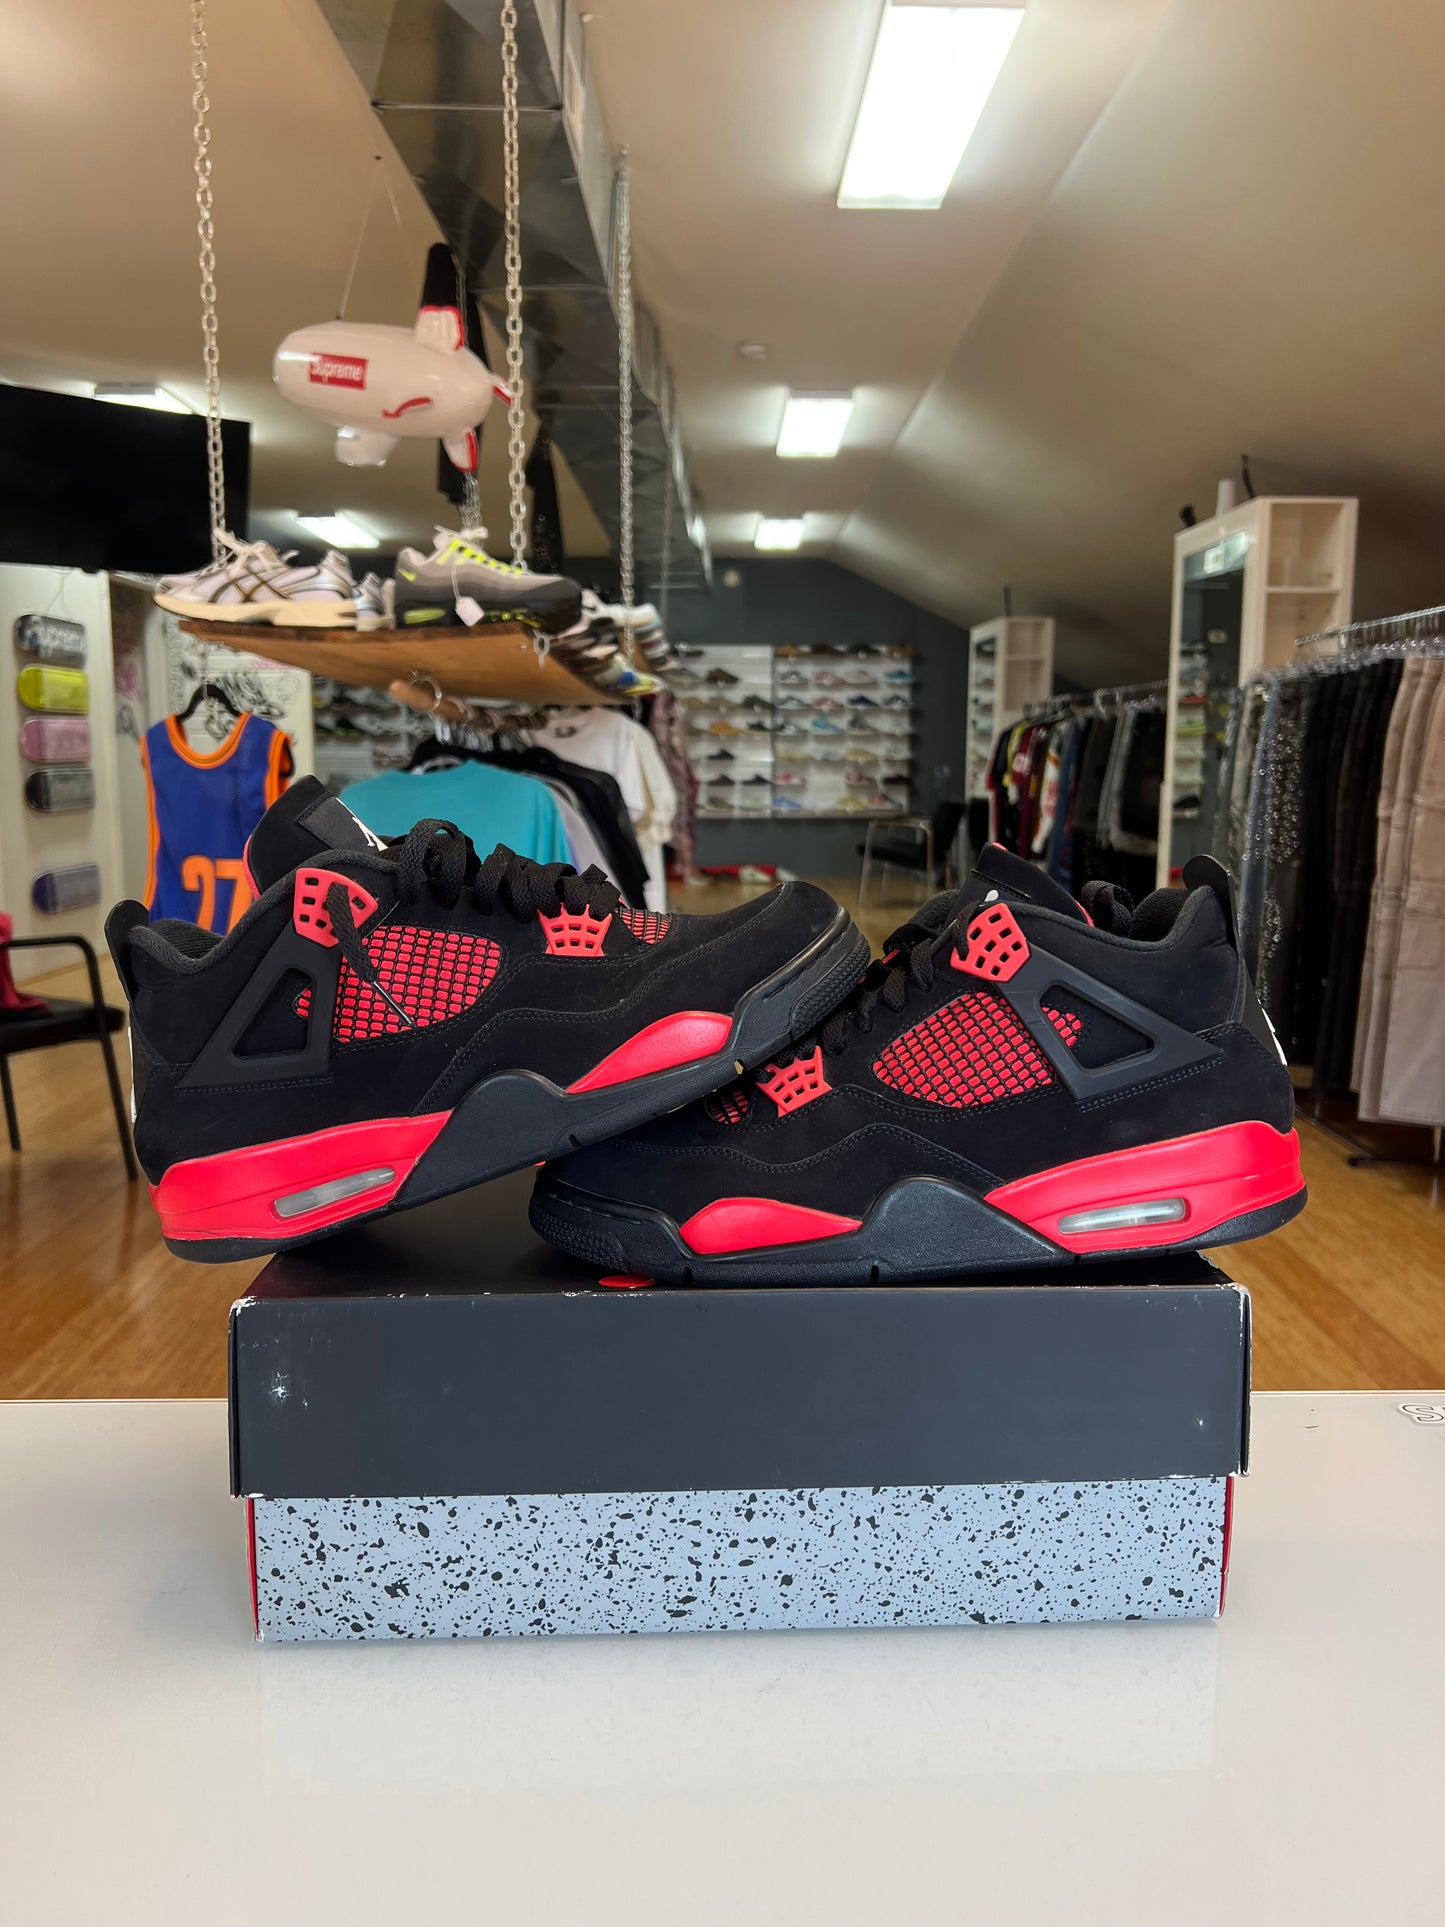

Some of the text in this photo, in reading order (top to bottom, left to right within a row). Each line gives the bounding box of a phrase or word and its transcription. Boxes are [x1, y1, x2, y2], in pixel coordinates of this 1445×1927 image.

[310, 359, 363, 383] Supreme
[182, 854, 252, 936] 27
[1402, 1404, 1445, 1421] S
